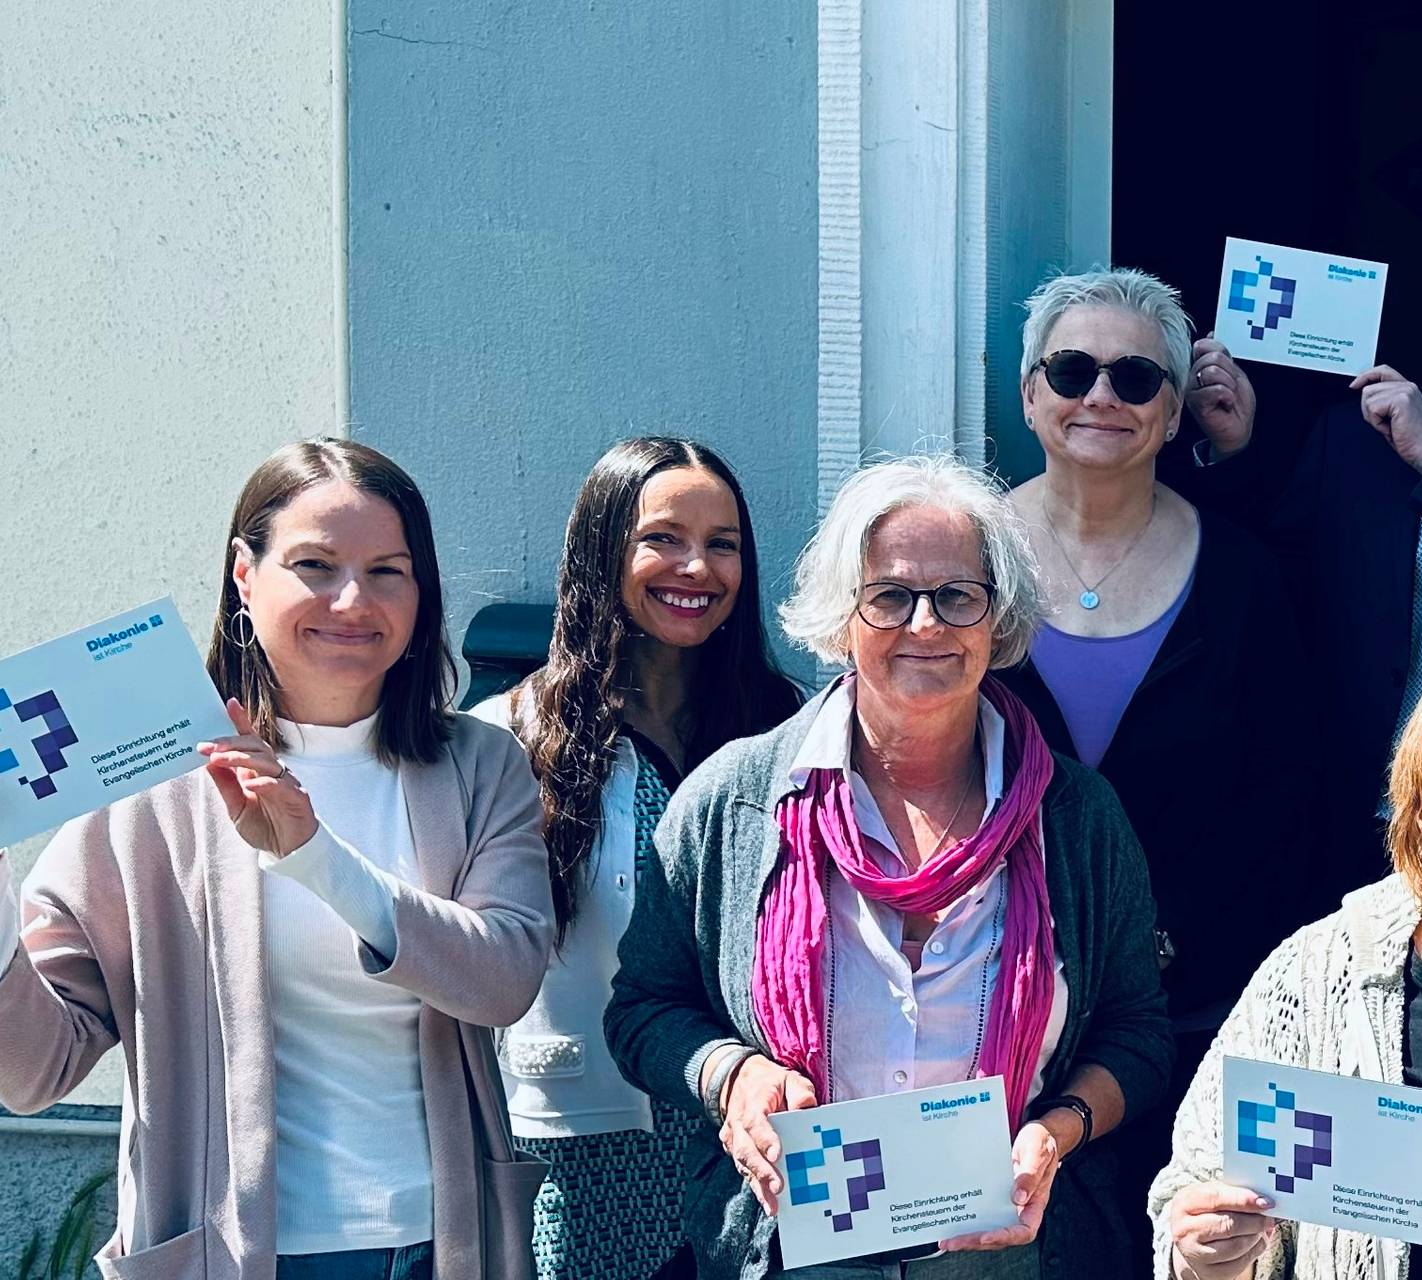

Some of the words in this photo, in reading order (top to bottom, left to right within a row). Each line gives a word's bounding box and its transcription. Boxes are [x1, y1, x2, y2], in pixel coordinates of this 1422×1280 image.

[1328, 264, 1367, 278] Diakonie
[86, 622, 149, 652] Diakonie
[104, 642, 133, 657] Kirche
[91, 750, 117, 764] Diese
[116, 729, 166, 754] Einrichtung
[166, 718, 192, 734] erhält
[97, 744, 163, 775] Kirchensteuern
[163, 738, 178, 749] der
[103, 757, 166, 787] Evangelischen
[165, 745, 193, 762] Kirche
[920, 1095, 977, 1113] Diakonie
[889, 1202, 913, 1212] Diese
[913, 1194, 959, 1207] Einrichtung
[960, 1188, 983, 1199] erhält
[1333, 1184, 1357, 1195] Diese
[1357, 1188, 1404, 1205] Einrichtung
[891, 1206, 952, 1222] Kirchensteuern
[952, 1203, 967, 1212] der
[1332, 1195, 1395, 1213] Kirchensteuern
[1395, 1207, 1409, 1216] der
[893, 1218, 950, 1234] Evangelischen
[951, 1213, 977, 1223] Kirche
[1332, 1206, 1392, 1223] Evangelischen
[1392, 1217, 1419, 1229] Kirche
